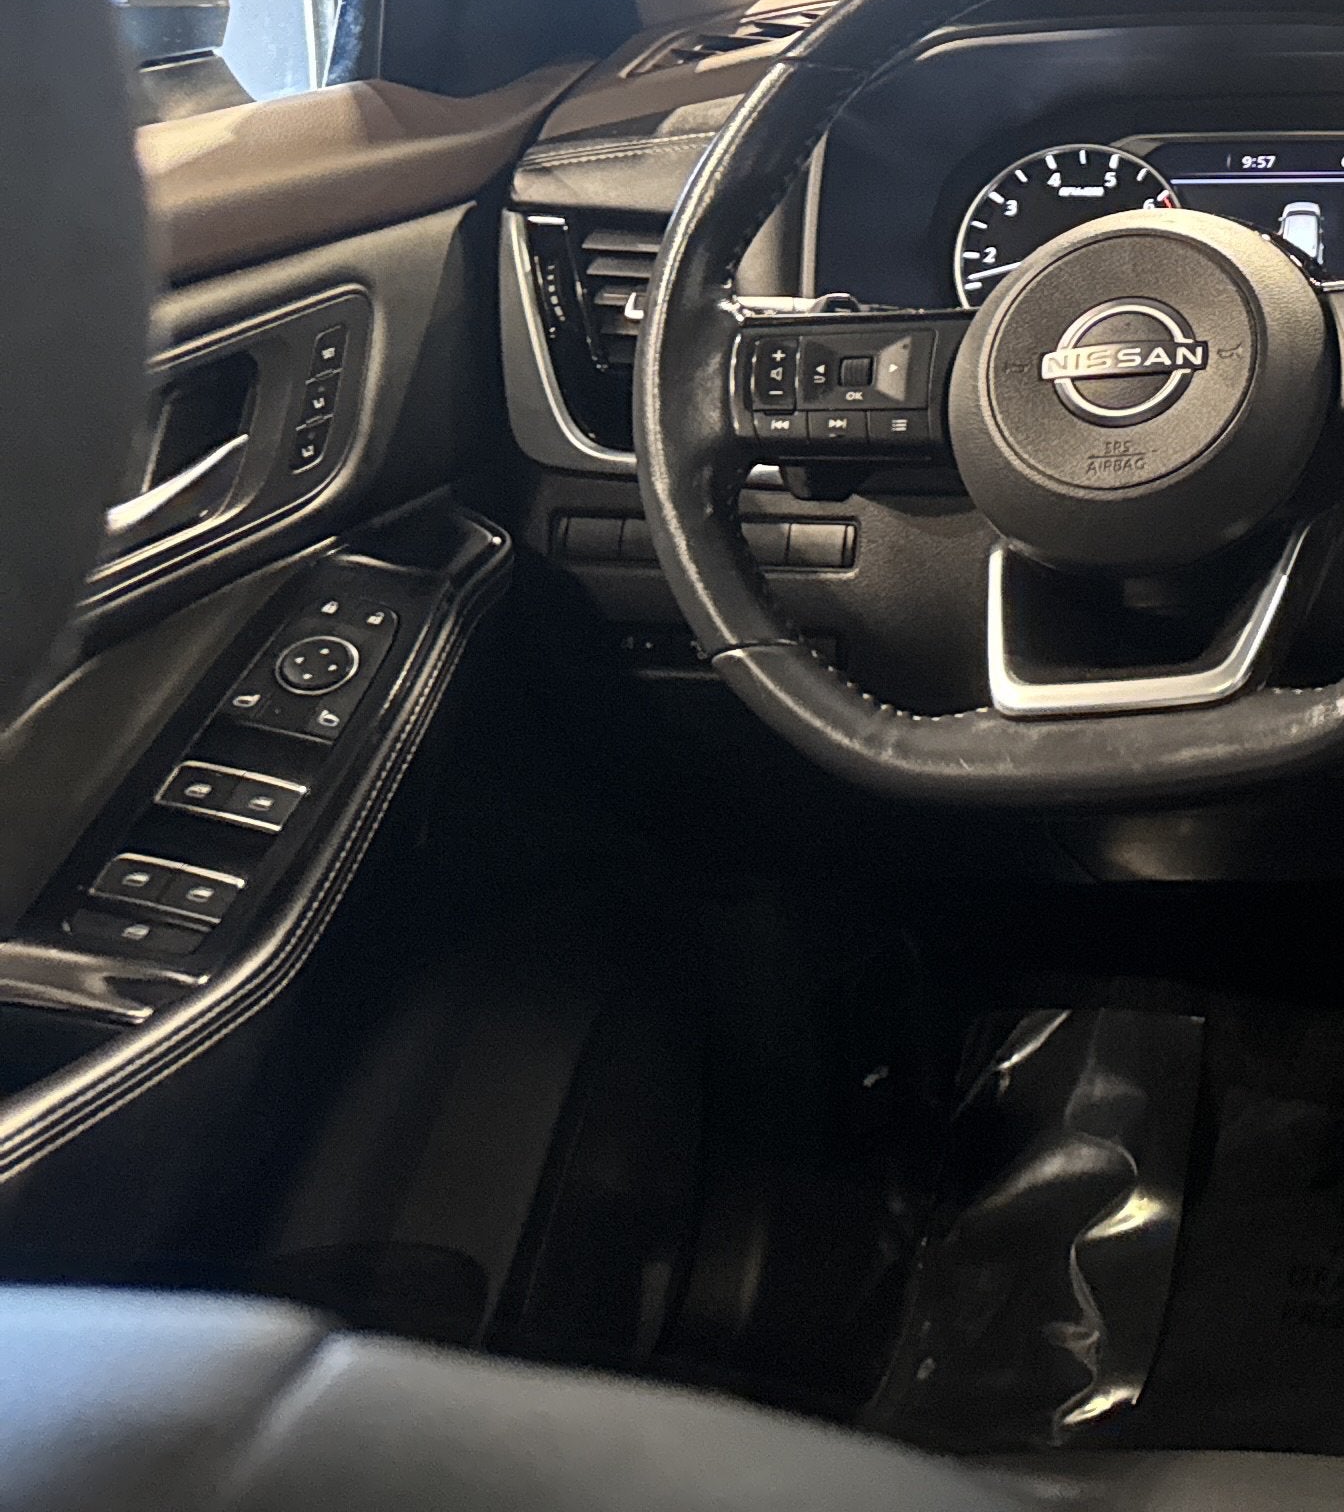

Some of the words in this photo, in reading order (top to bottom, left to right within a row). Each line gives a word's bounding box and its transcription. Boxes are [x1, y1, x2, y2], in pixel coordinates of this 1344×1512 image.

[1240, 155, 1277, 168] 9:57
[1046, 171, 1062, 188] 4
[1104, 170, 1118, 188] 5
[1003, 199, 1019, 218] 3
[1142, 198, 1156, 210] 6
[982, 246, 998, 264] 2
[1047, 346, 1204, 371] NISSAN
[845, 391, 864, 402] OK
[1104, 440, 1132, 455] SRS
[1085, 457, 1146, 476] AIRBAG
